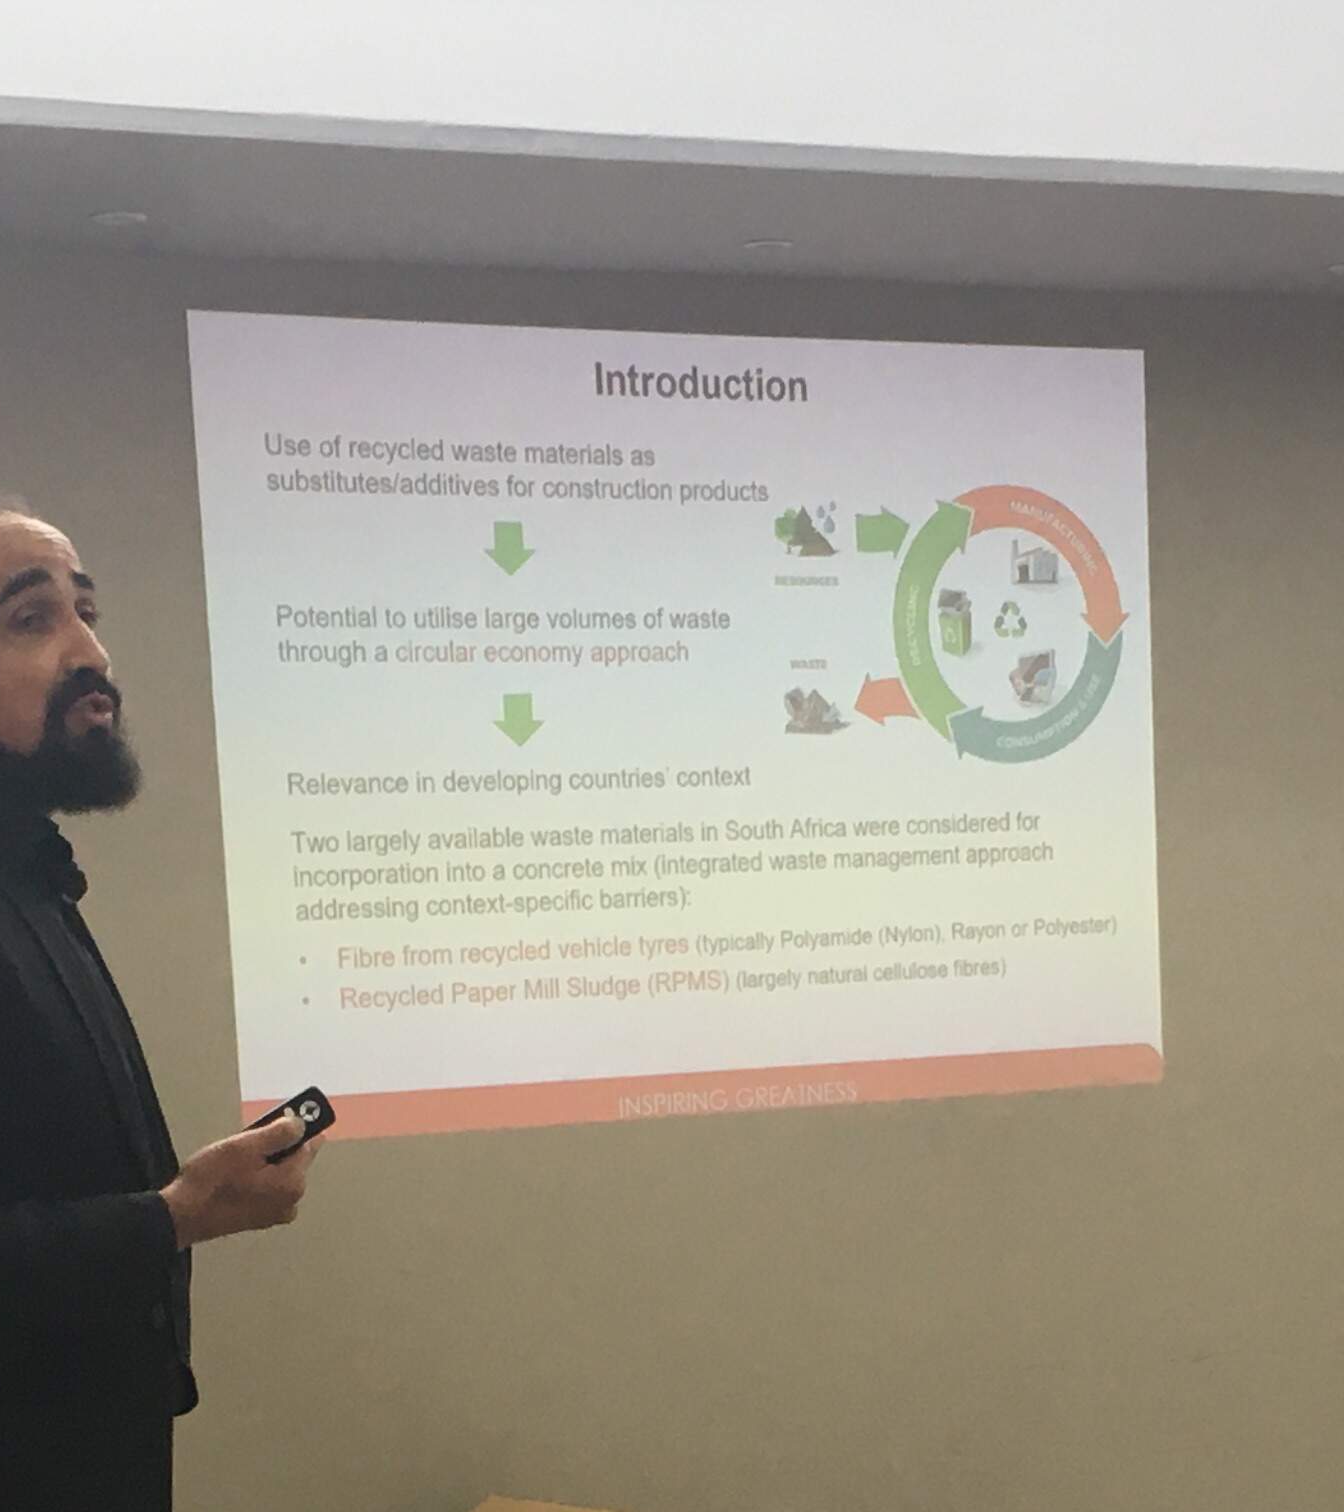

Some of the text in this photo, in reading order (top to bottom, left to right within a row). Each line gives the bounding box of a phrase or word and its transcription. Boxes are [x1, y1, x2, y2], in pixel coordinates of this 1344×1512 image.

[595, 361, 808, 402] Introduction
[264, 432, 655, 466] Use of recycled waste materials as
[267, 469, 769, 506] substitutes/additives for construction products
[276, 604, 730, 635] Potential to utilise large volumes of waste
[278, 639, 689, 668] through a circular economy approach
[287, 772, 409, 795] Relevance
[416, 771, 435, 793] in
[443, 769, 562, 796] developing
[676, 766, 751, 787] context
[296, 896, 419, 923] addressing
[426, 889, 594, 918] context-specific
[338, 947, 395, 969] Fibre
[402, 944, 453, 966] from
[460, 939, 550, 968] recycled
[558, 935, 632, 959] vehicle
[638, 936, 689, 961] tyres
[695, 931, 775, 957] (typically
[780, 928, 873, 951] Polyamide
[951, 922, 1006, 944] Rayon
[1011, 923, 1029, 938] or
[1034, 916, 1117, 938] Polyester)
[619, 1089, 728, 1119] INSPIRING
